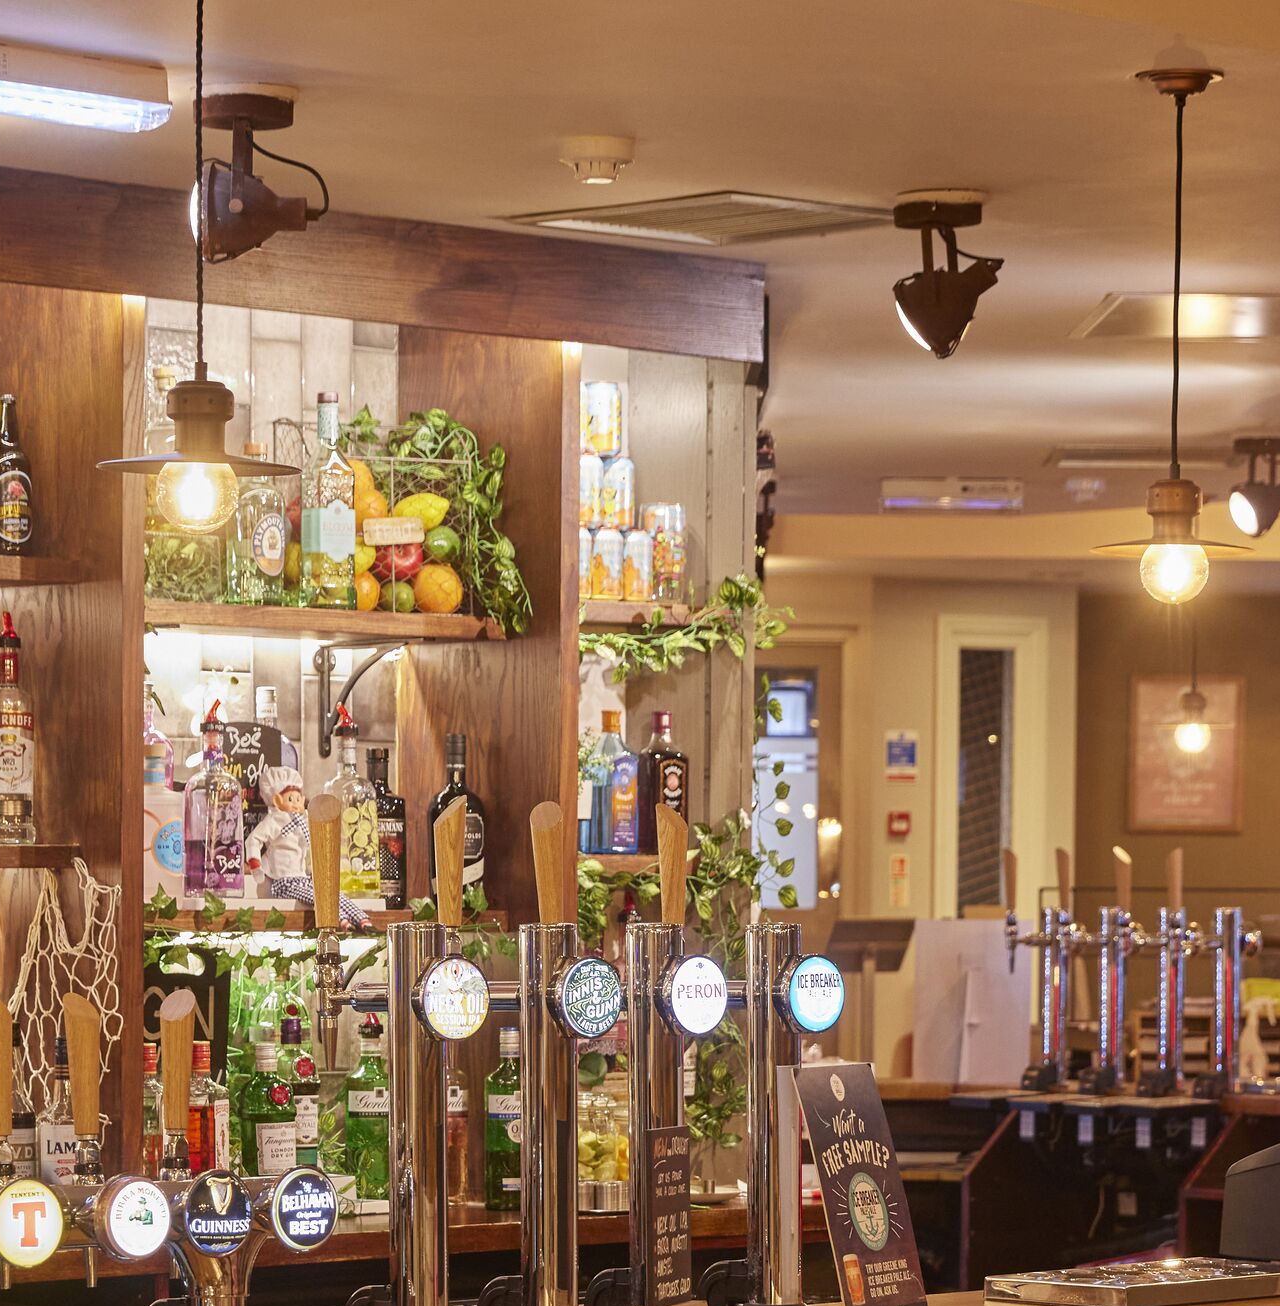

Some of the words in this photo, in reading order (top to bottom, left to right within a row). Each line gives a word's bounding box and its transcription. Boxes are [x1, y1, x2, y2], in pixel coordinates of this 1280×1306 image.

[215, 854, 241, 875] Boë
[568, 977, 603, 1004] INNIS
[797, 974, 809, 989] ICE
[809, 973, 840, 988] BREAKER
[677, 983, 726, 999] PERONI
[144, 985, 215, 1041] GN
[466, 992, 486, 1015] OIL
[585, 993, 620, 1019] GUNN
[434, 1012, 468, 1025] SESSION
[469, 1012, 481, 1025] IPA
[577, 1017, 597, 1031] LAGER
[598, 1016, 614, 1030] BEER
[831, 1108, 856, 1138] Want
[46, 1139, 78, 1156] LAM
[822, 1143, 844, 1178] FREE
[843, 1138, 890, 1170] SAMPLE?
[282, 1191, 334, 1213] BELHAVEN
[12, 1201, 47, 1247] T
[191, 1217, 251, 1234] GUINNESS
[289, 1219, 329, 1235] BEST
[882, 1260, 897, 1272] GREENE
[874, 1273, 893, 1286] BREAKER
